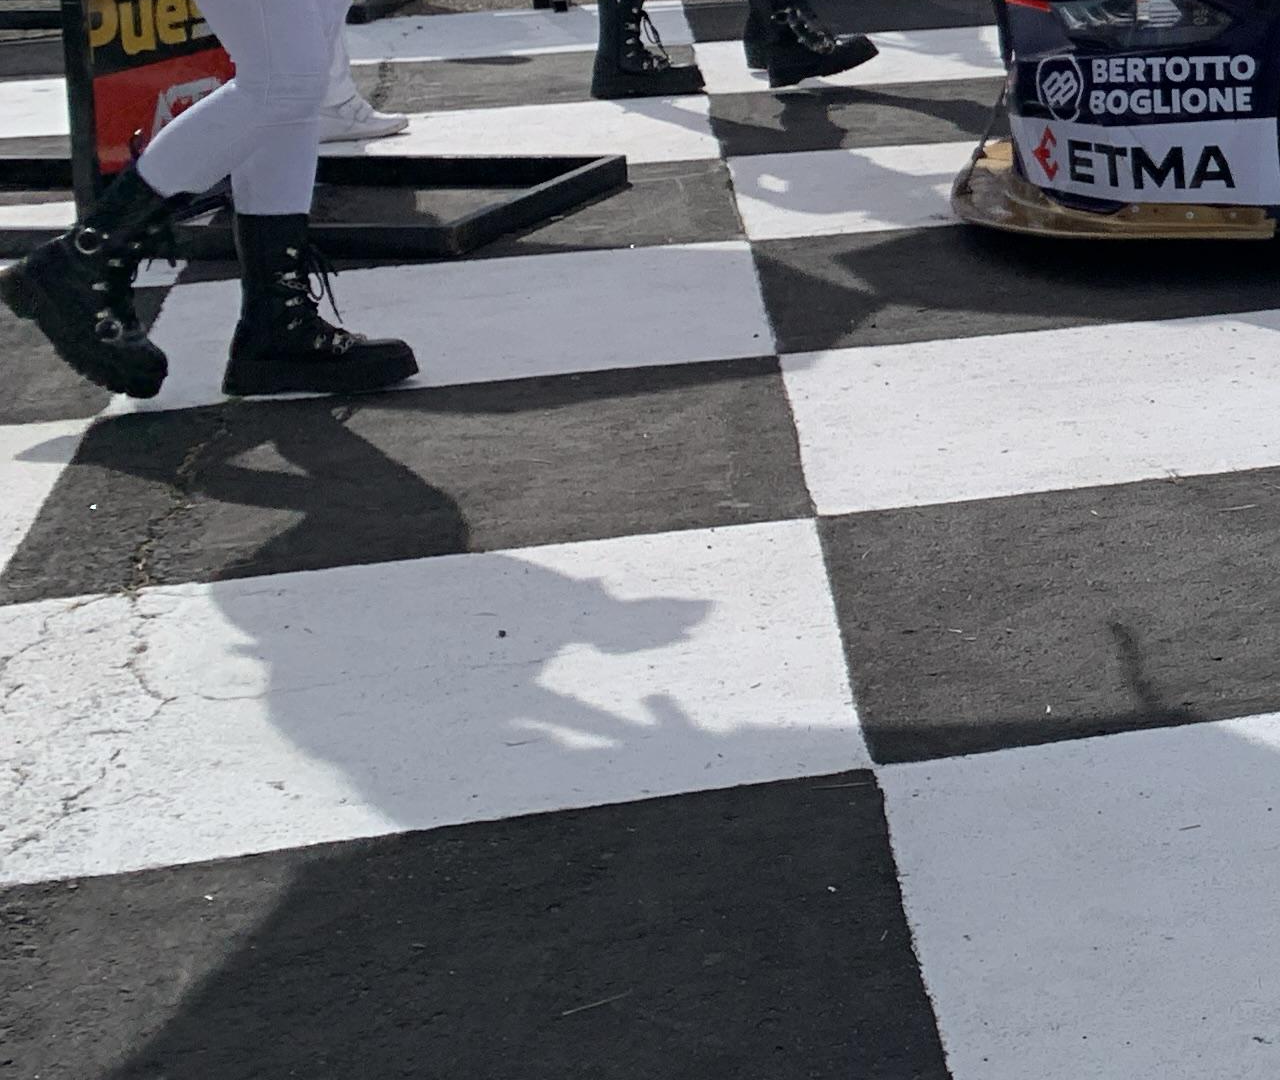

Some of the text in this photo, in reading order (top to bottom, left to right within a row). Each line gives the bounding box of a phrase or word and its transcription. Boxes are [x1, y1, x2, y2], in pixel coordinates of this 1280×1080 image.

[1091, 54, 1257, 84] BERTOTTO
[1089, 86, 1253, 115] BOGLIONE
[1067, 139, 1236, 190] ETMA
